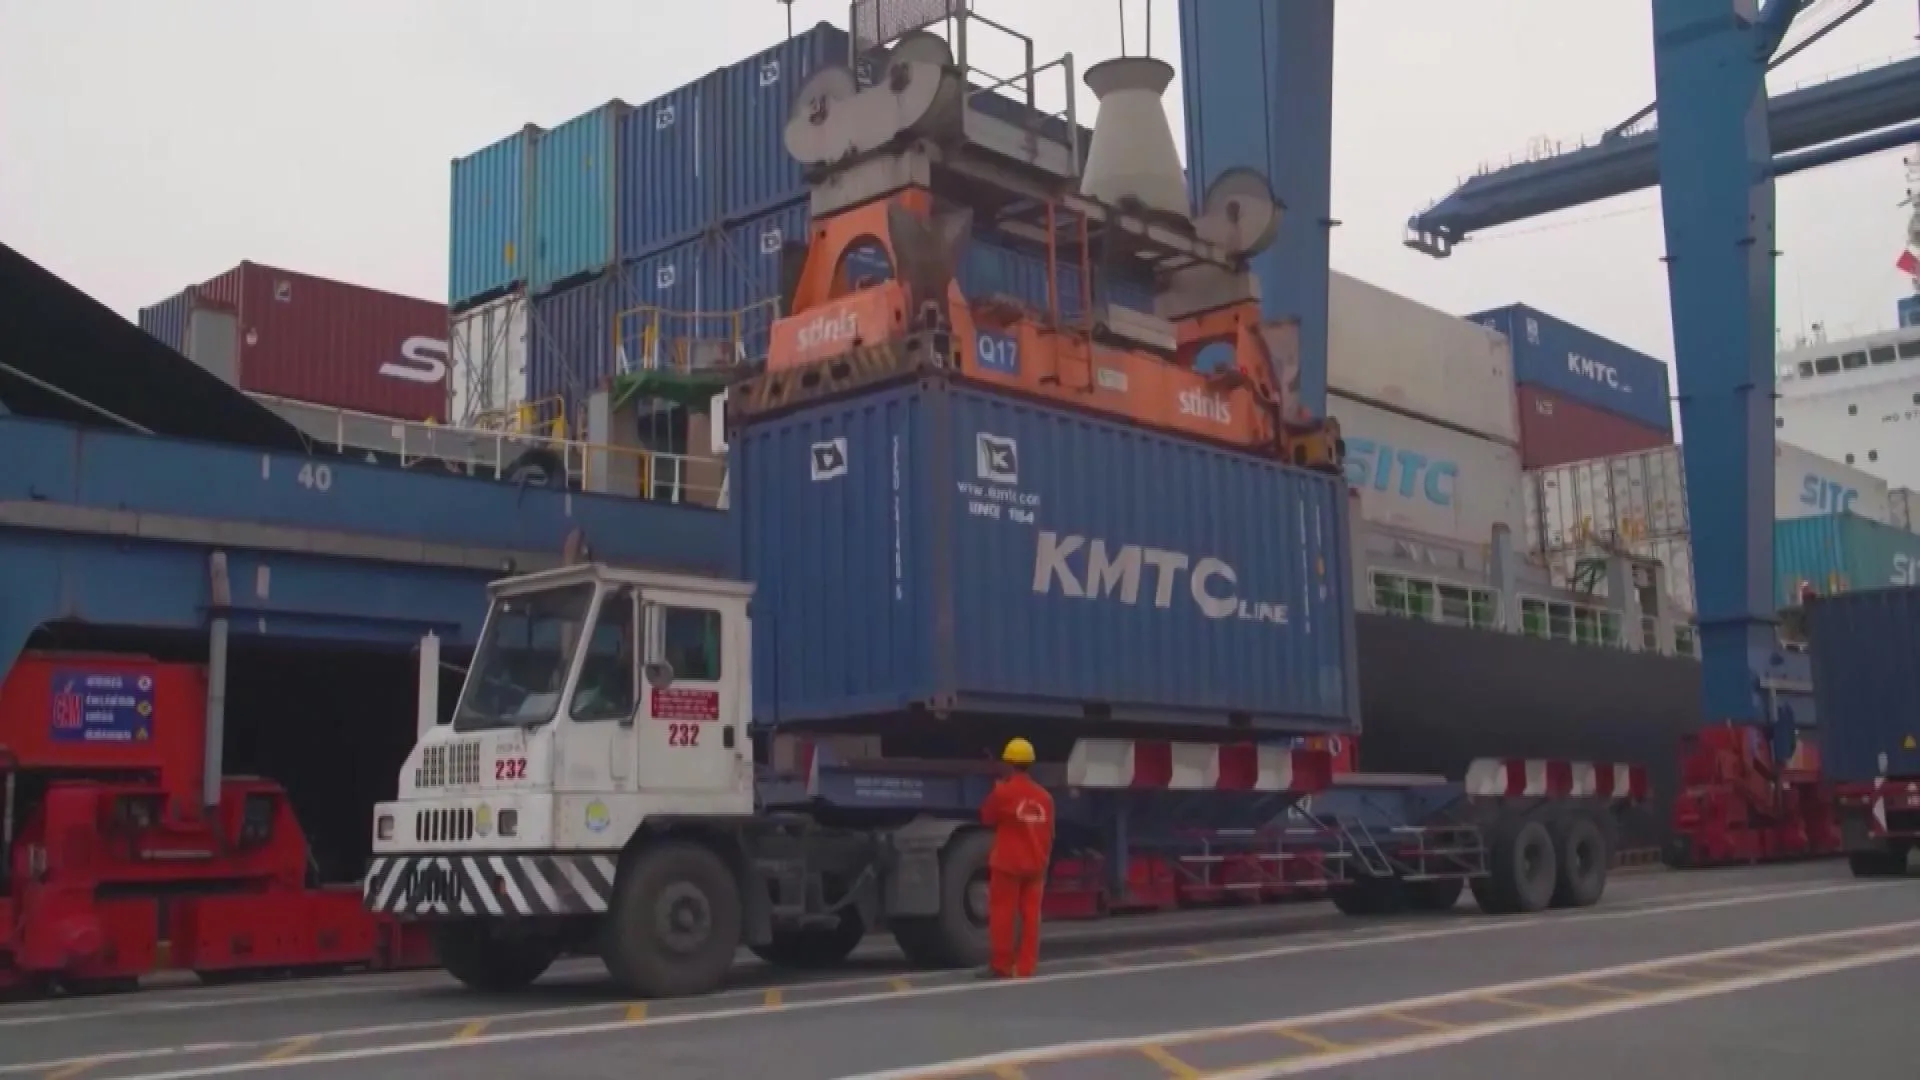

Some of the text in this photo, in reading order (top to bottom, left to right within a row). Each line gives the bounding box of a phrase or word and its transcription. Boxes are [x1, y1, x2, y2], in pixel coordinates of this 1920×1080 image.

[978, 334, 1017, 367] Q17
[1567, 351, 1619, 389] KMTC
[297, 465, 332, 492] 40
[1344, 437, 1459, 506] SITC
[1032, 531, 1289, 625] KMTC LINE
[1889, 552, 1920, 586] SI
[668, 723, 700, 748] 232
[495, 757, 529, 780] 232
